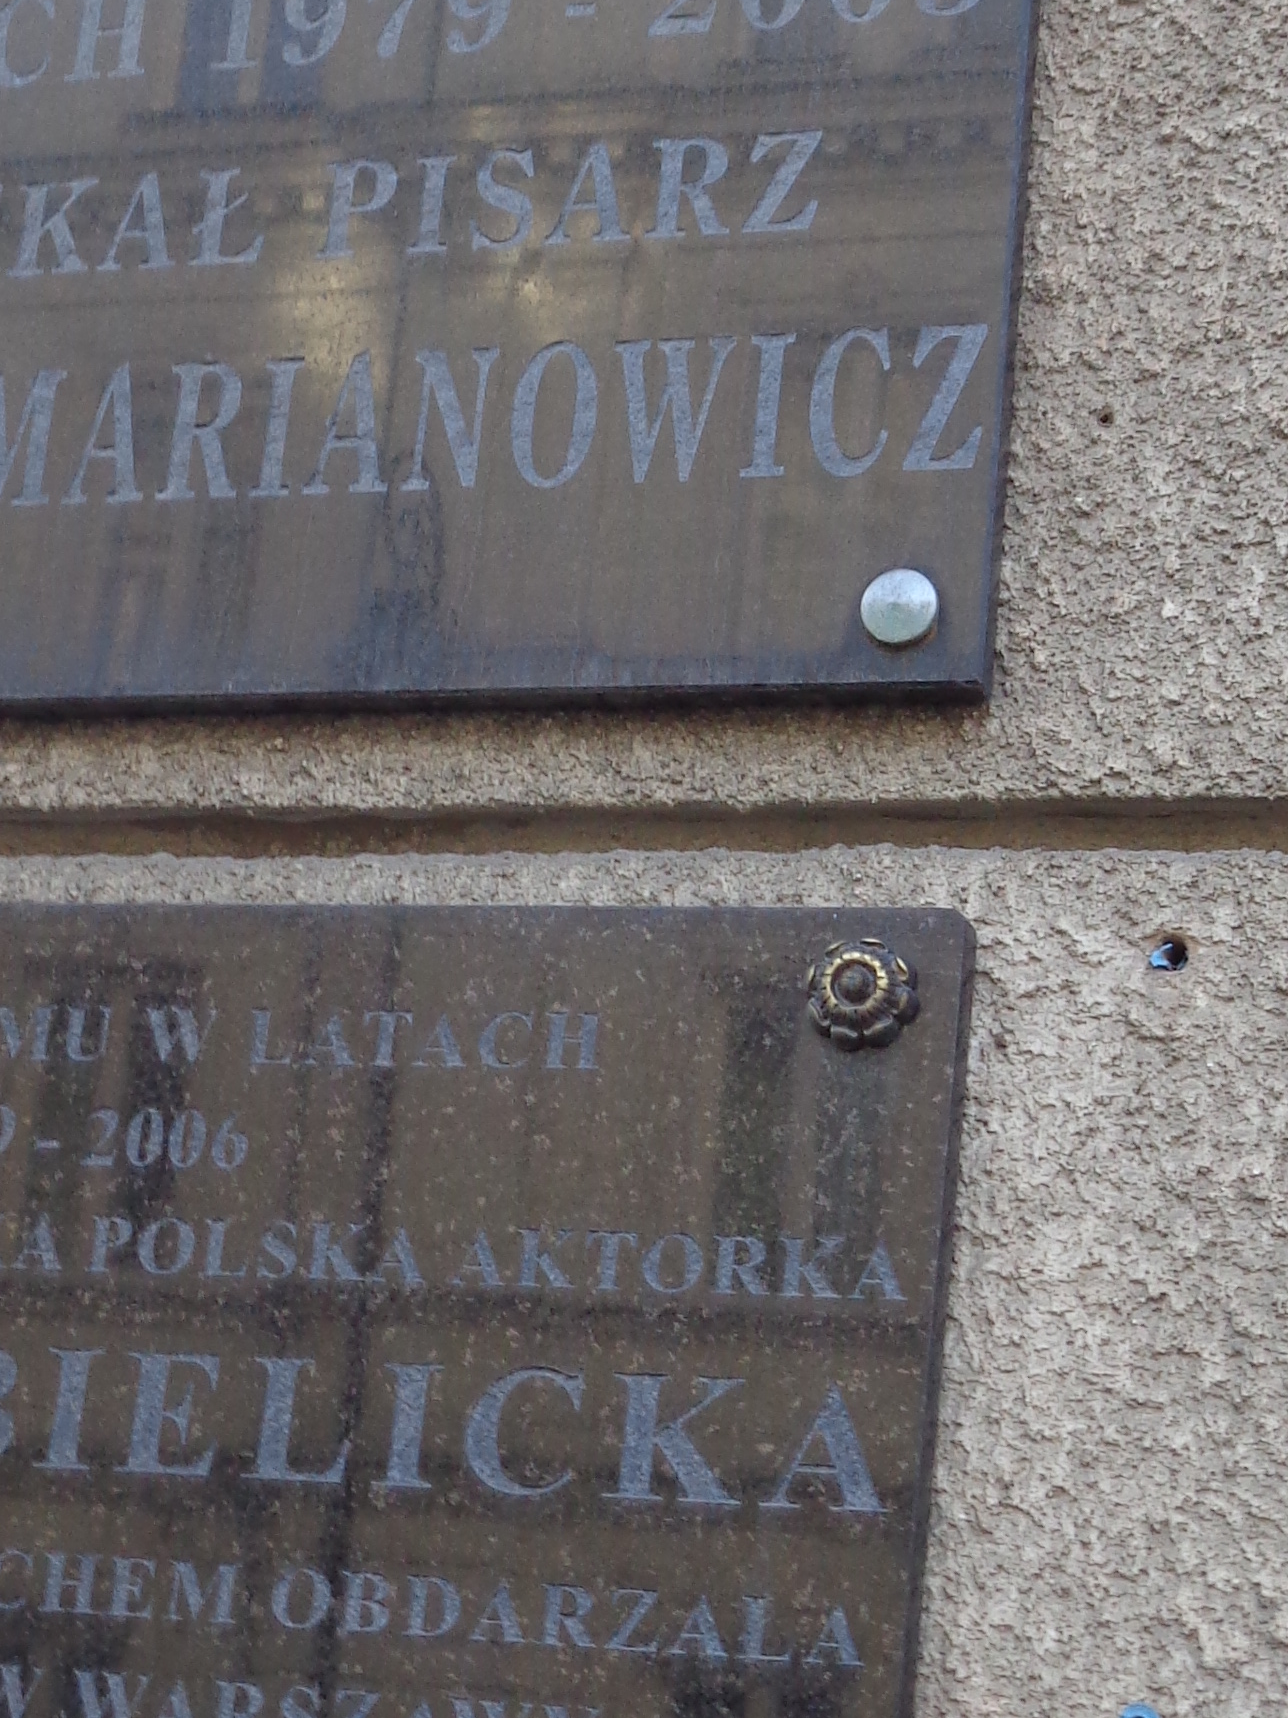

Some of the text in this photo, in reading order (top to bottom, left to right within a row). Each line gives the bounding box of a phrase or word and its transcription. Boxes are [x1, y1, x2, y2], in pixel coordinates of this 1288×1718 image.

[312, 129, 824, 261] PISARZ
[148, 1004, 219, 1065] W
[249, 1005, 601, 1072] LATACH
[79, 1106, 250, 1172] 2006
[91, 1213, 426, 1286] POLSKA
[451, 1226, 910, 1303] AKTORKA
